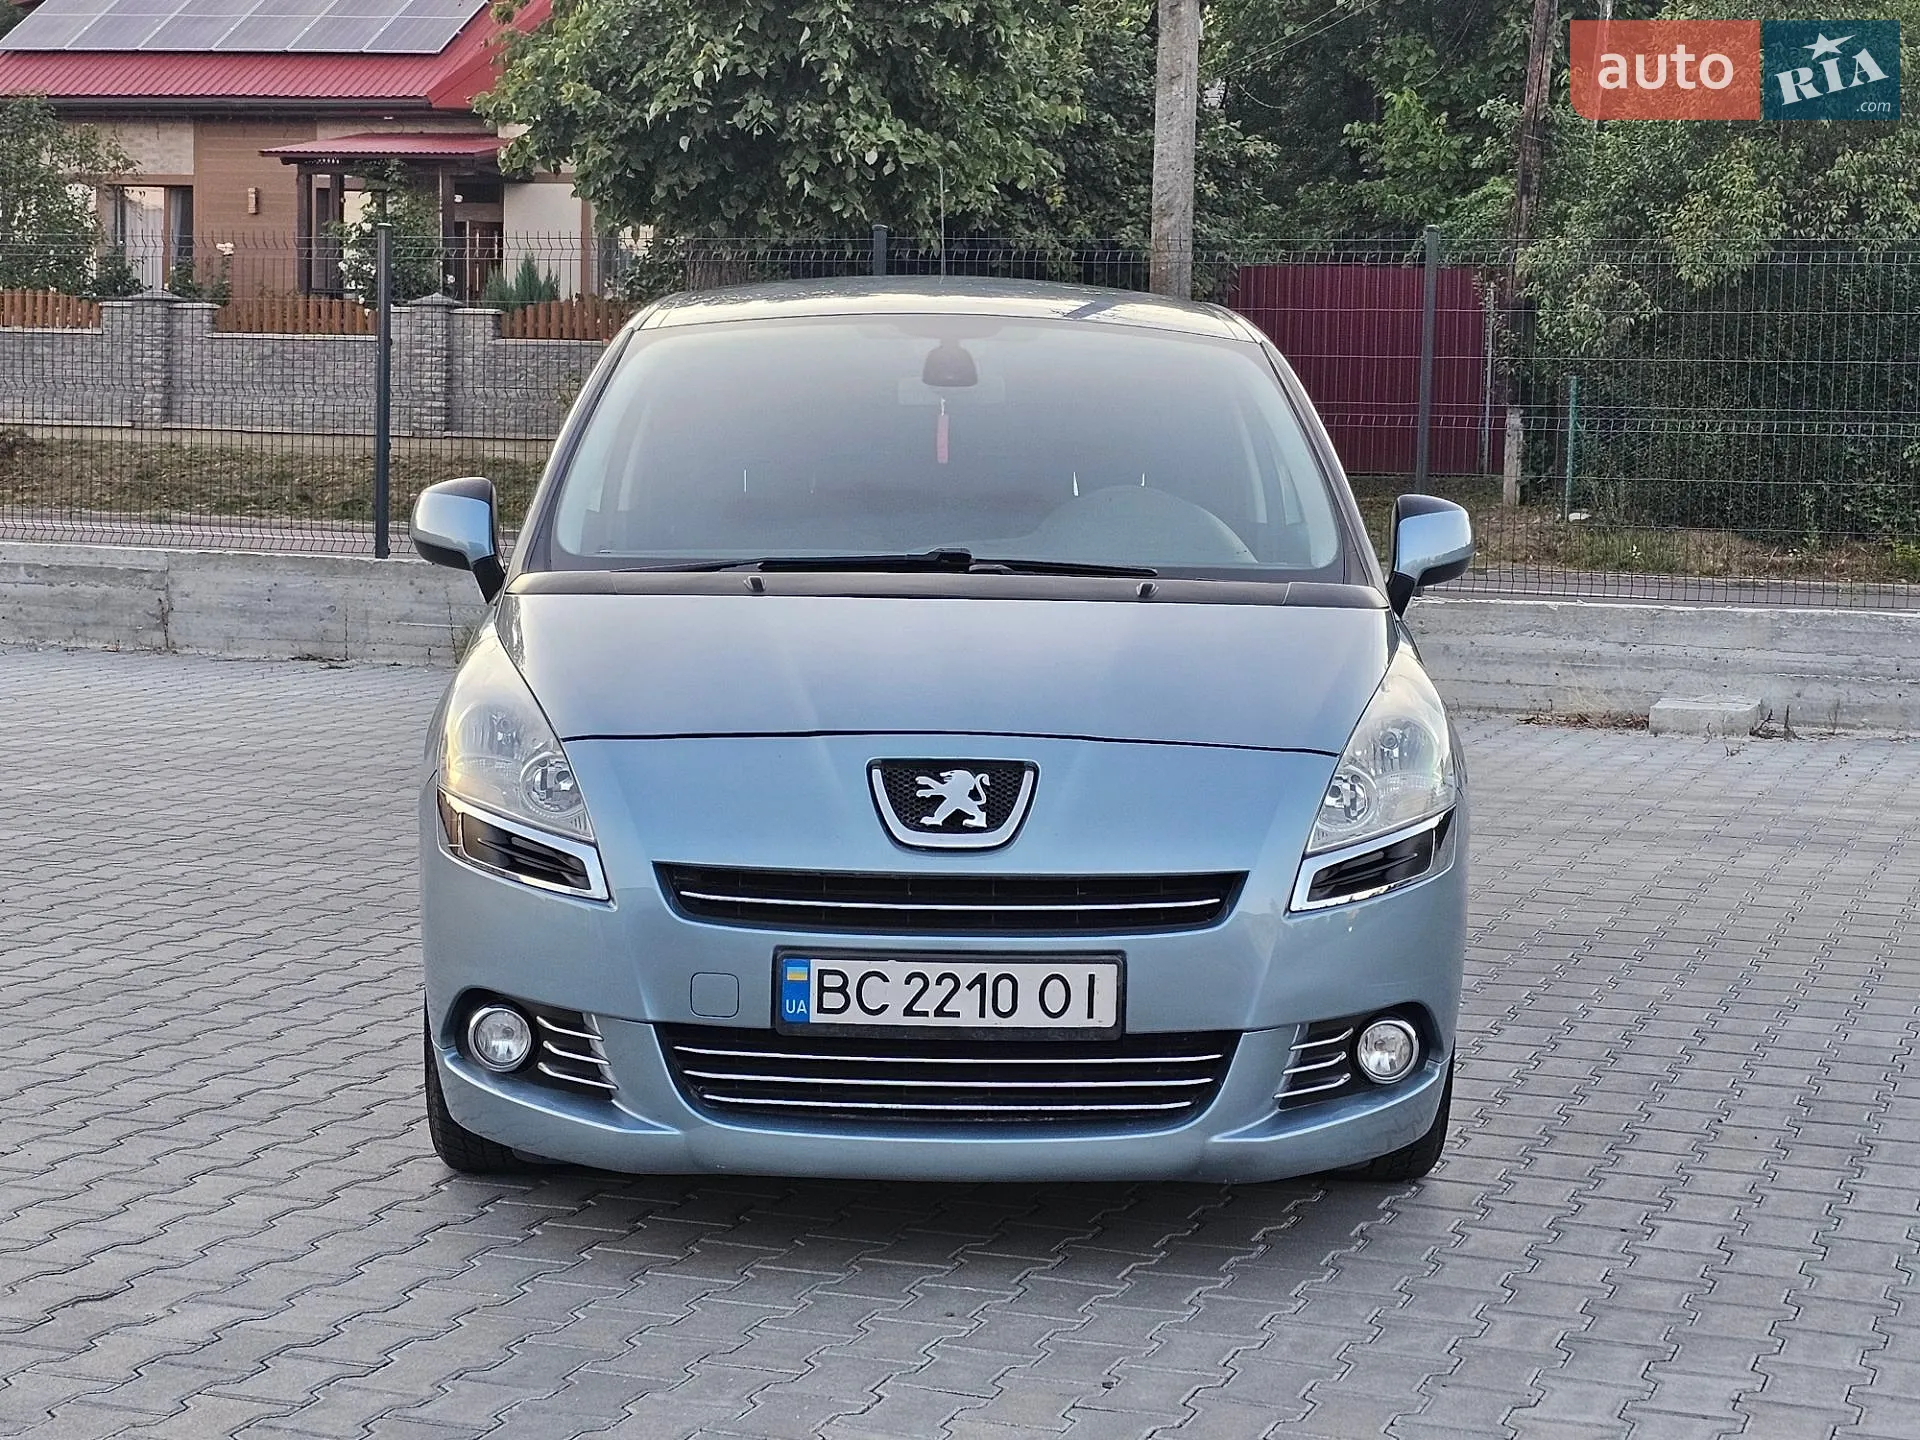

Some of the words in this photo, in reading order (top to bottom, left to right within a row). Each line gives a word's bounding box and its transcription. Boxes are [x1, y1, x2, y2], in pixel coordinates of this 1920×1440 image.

[786, 999, 807, 1014] UA
[816, 968, 890, 1016] BC
[902, 972, 1019, 1019] 2210
